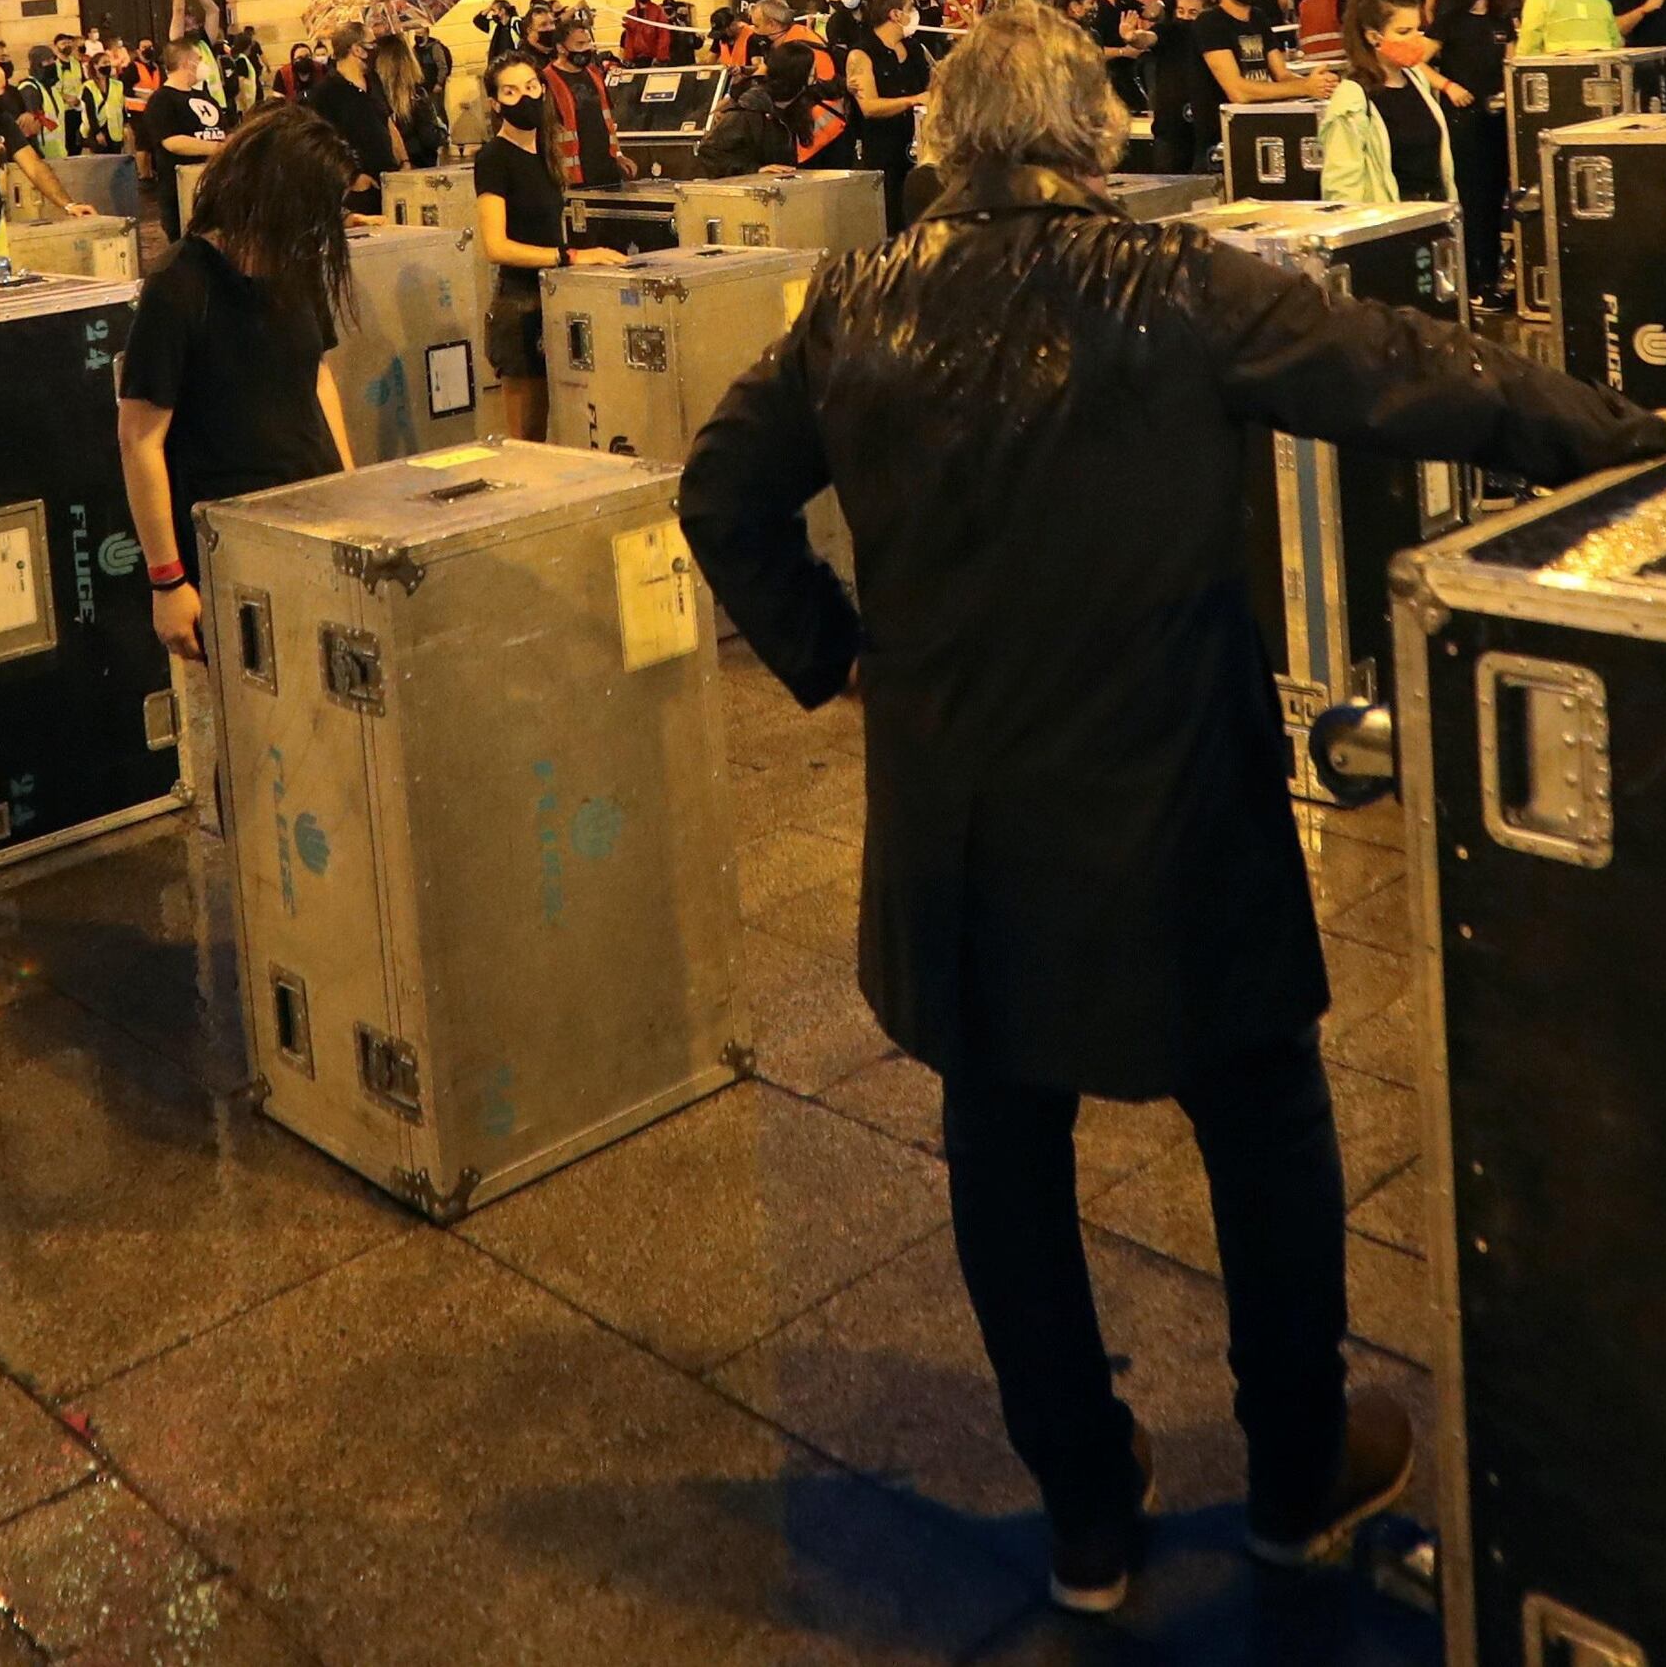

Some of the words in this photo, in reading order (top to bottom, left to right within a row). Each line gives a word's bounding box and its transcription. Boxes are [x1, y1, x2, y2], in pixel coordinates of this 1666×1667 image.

[85, 318, 111, 371] 24
[1602, 293, 1624, 392] FLUGE
[70, 503, 96, 624] FLUGE
